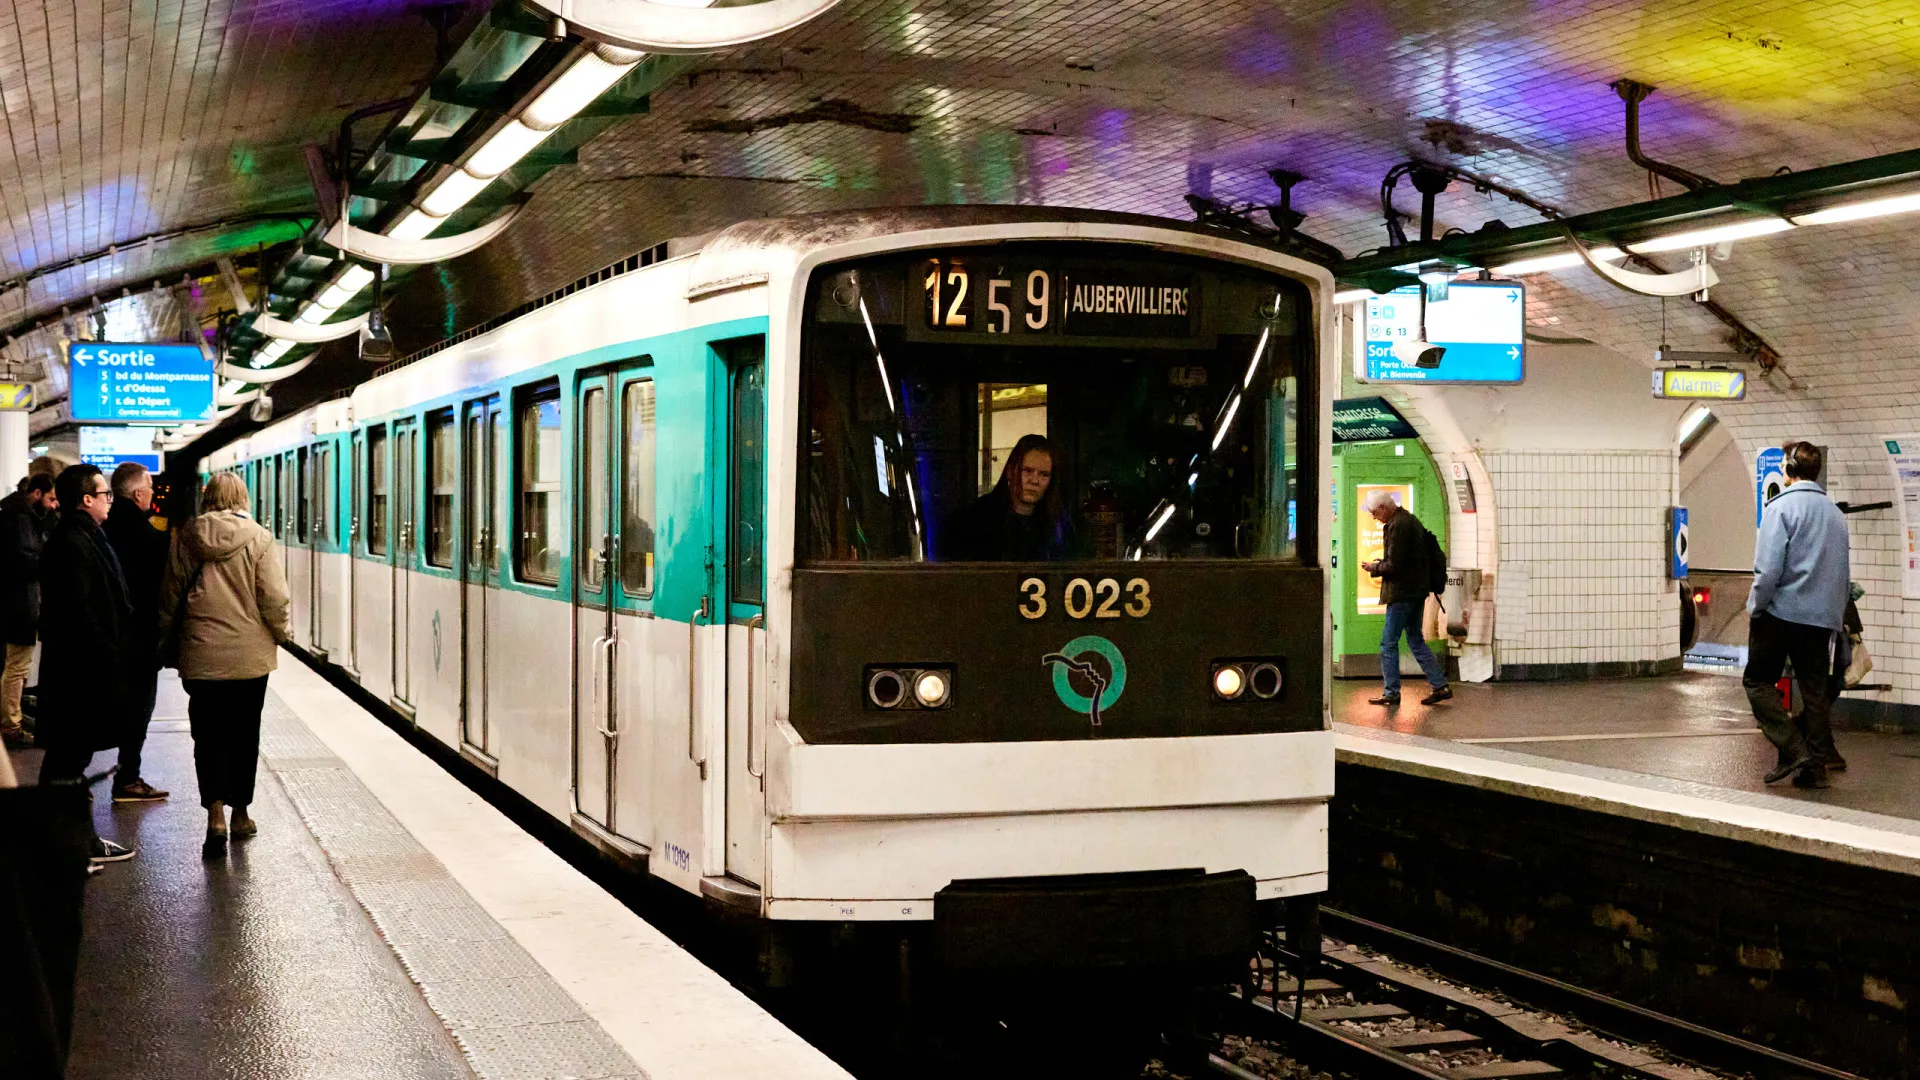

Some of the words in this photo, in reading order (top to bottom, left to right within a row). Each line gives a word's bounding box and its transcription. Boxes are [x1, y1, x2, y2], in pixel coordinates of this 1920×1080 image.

[925, 264, 968, 327] 12
[1072, 283, 1189, 317] AUBERVILLIERS
[1386, 328, 1392, 336] 6
[1398, 328, 1407, 336] 13
[1368, 345, 1395, 357] Sort
[97, 349, 155, 367] Sortie
[1371, 361, 1376, 369] 1
[1380, 361, 1399, 369] Porte
[101, 371, 109, 381] 5
[115, 372, 129, 381] bd
[130, 372, 143, 381] du
[145, 372, 211, 382] Montparnasse
[1371, 371, 1377, 379] 2
[101, 384, 109, 393] 6
[123, 383, 166, 393] d'Odessa
[1670, 377, 1721, 392] Alarme
[101, 396, 108, 405] 7
[1447, 577, 1464, 586] erci
[1019, 578, 1047, 619] 3
[1064, 577, 1152, 619] 023
[671, 844, 690, 873] 10191
